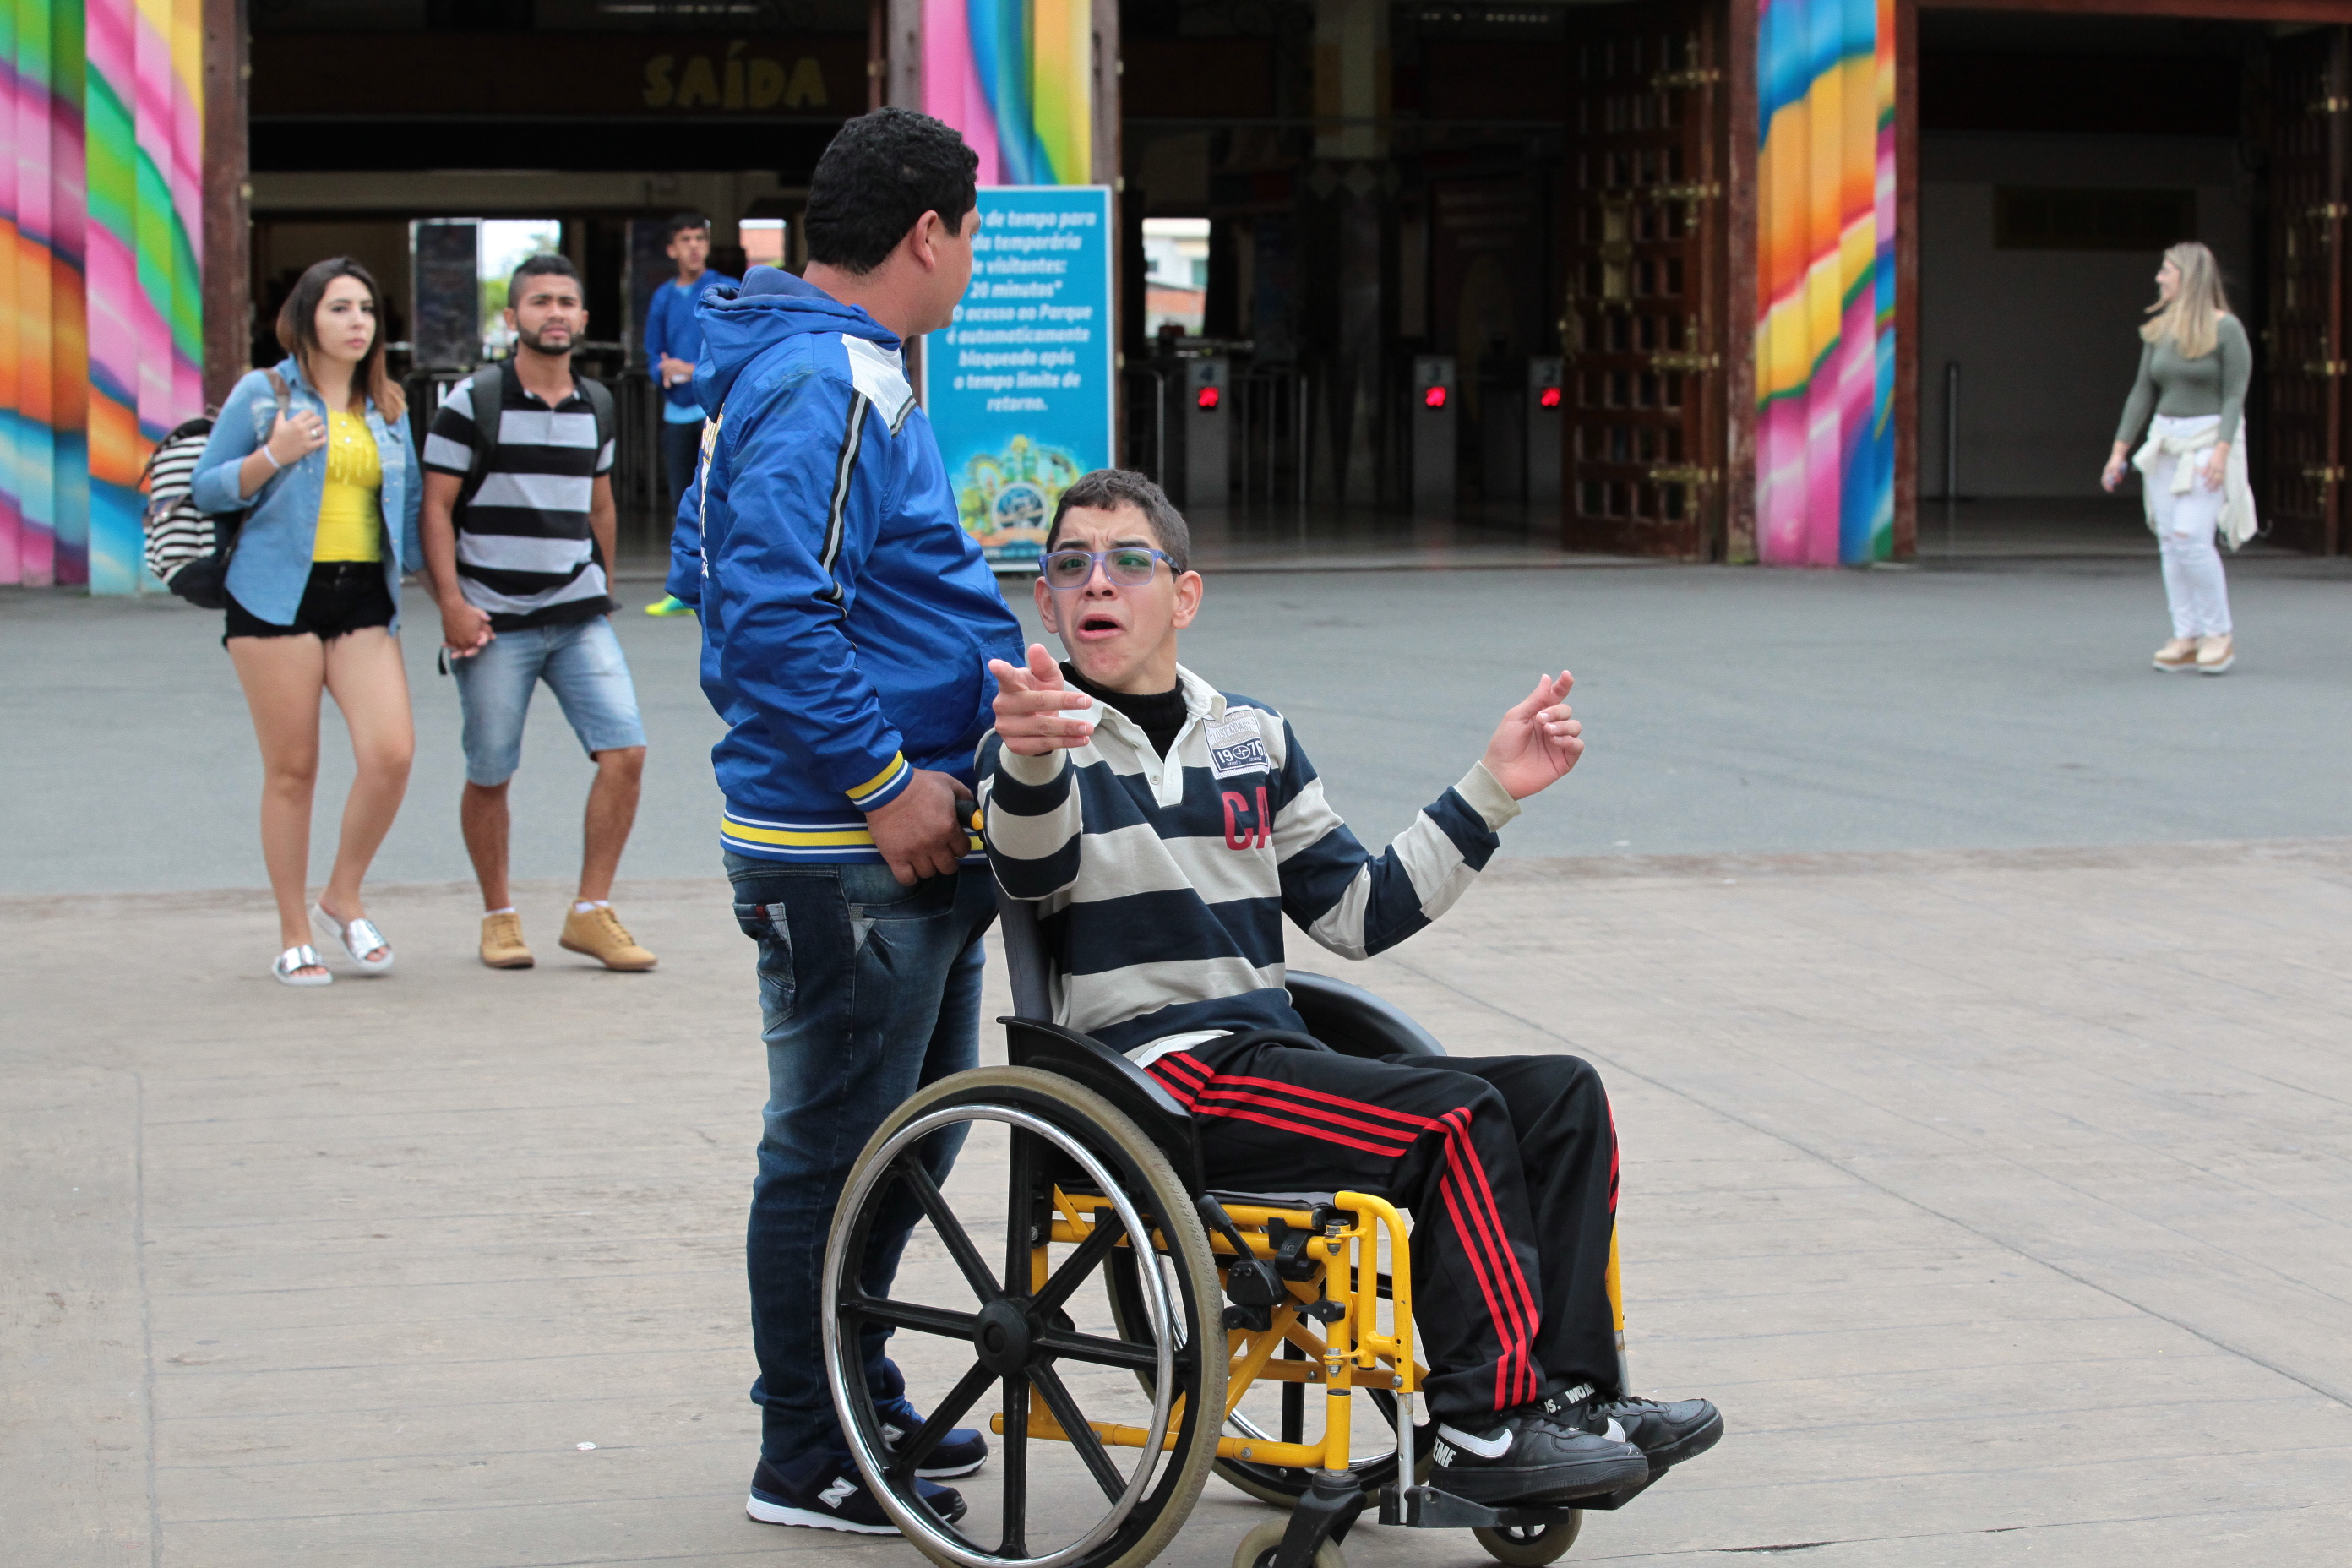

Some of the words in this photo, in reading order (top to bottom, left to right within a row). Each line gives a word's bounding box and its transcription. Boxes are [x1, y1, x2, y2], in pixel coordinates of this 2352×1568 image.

[643, 41, 828, 110] SAÍDA
[985, 209, 1005, 228] de
[1007, 210, 1057, 231] tempo
[1058, 211, 1097, 231] para
[994, 231, 1082, 255] temporária
[985, 256, 1067, 275] visitantes:
[970, 281, 990, 299] 20
[953, 304, 964, 322] O
[966, 308, 1015, 323] acesso
[1016, 307, 1037, 322] ao
[1038, 303, 1093, 324] Parque
[958, 325, 1091, 345] automaticamente
[958, 348, 1038, 371] bloqueado
[1039, 347, 1075, 369] após
[953, 376, 965, 391] o
[966, 373, 1015, 393] tempo
[1016, 370, 1061, 389] limite
[1061, 370, 1082, 389] de
[987, 395, 1049, 413] retorno.
